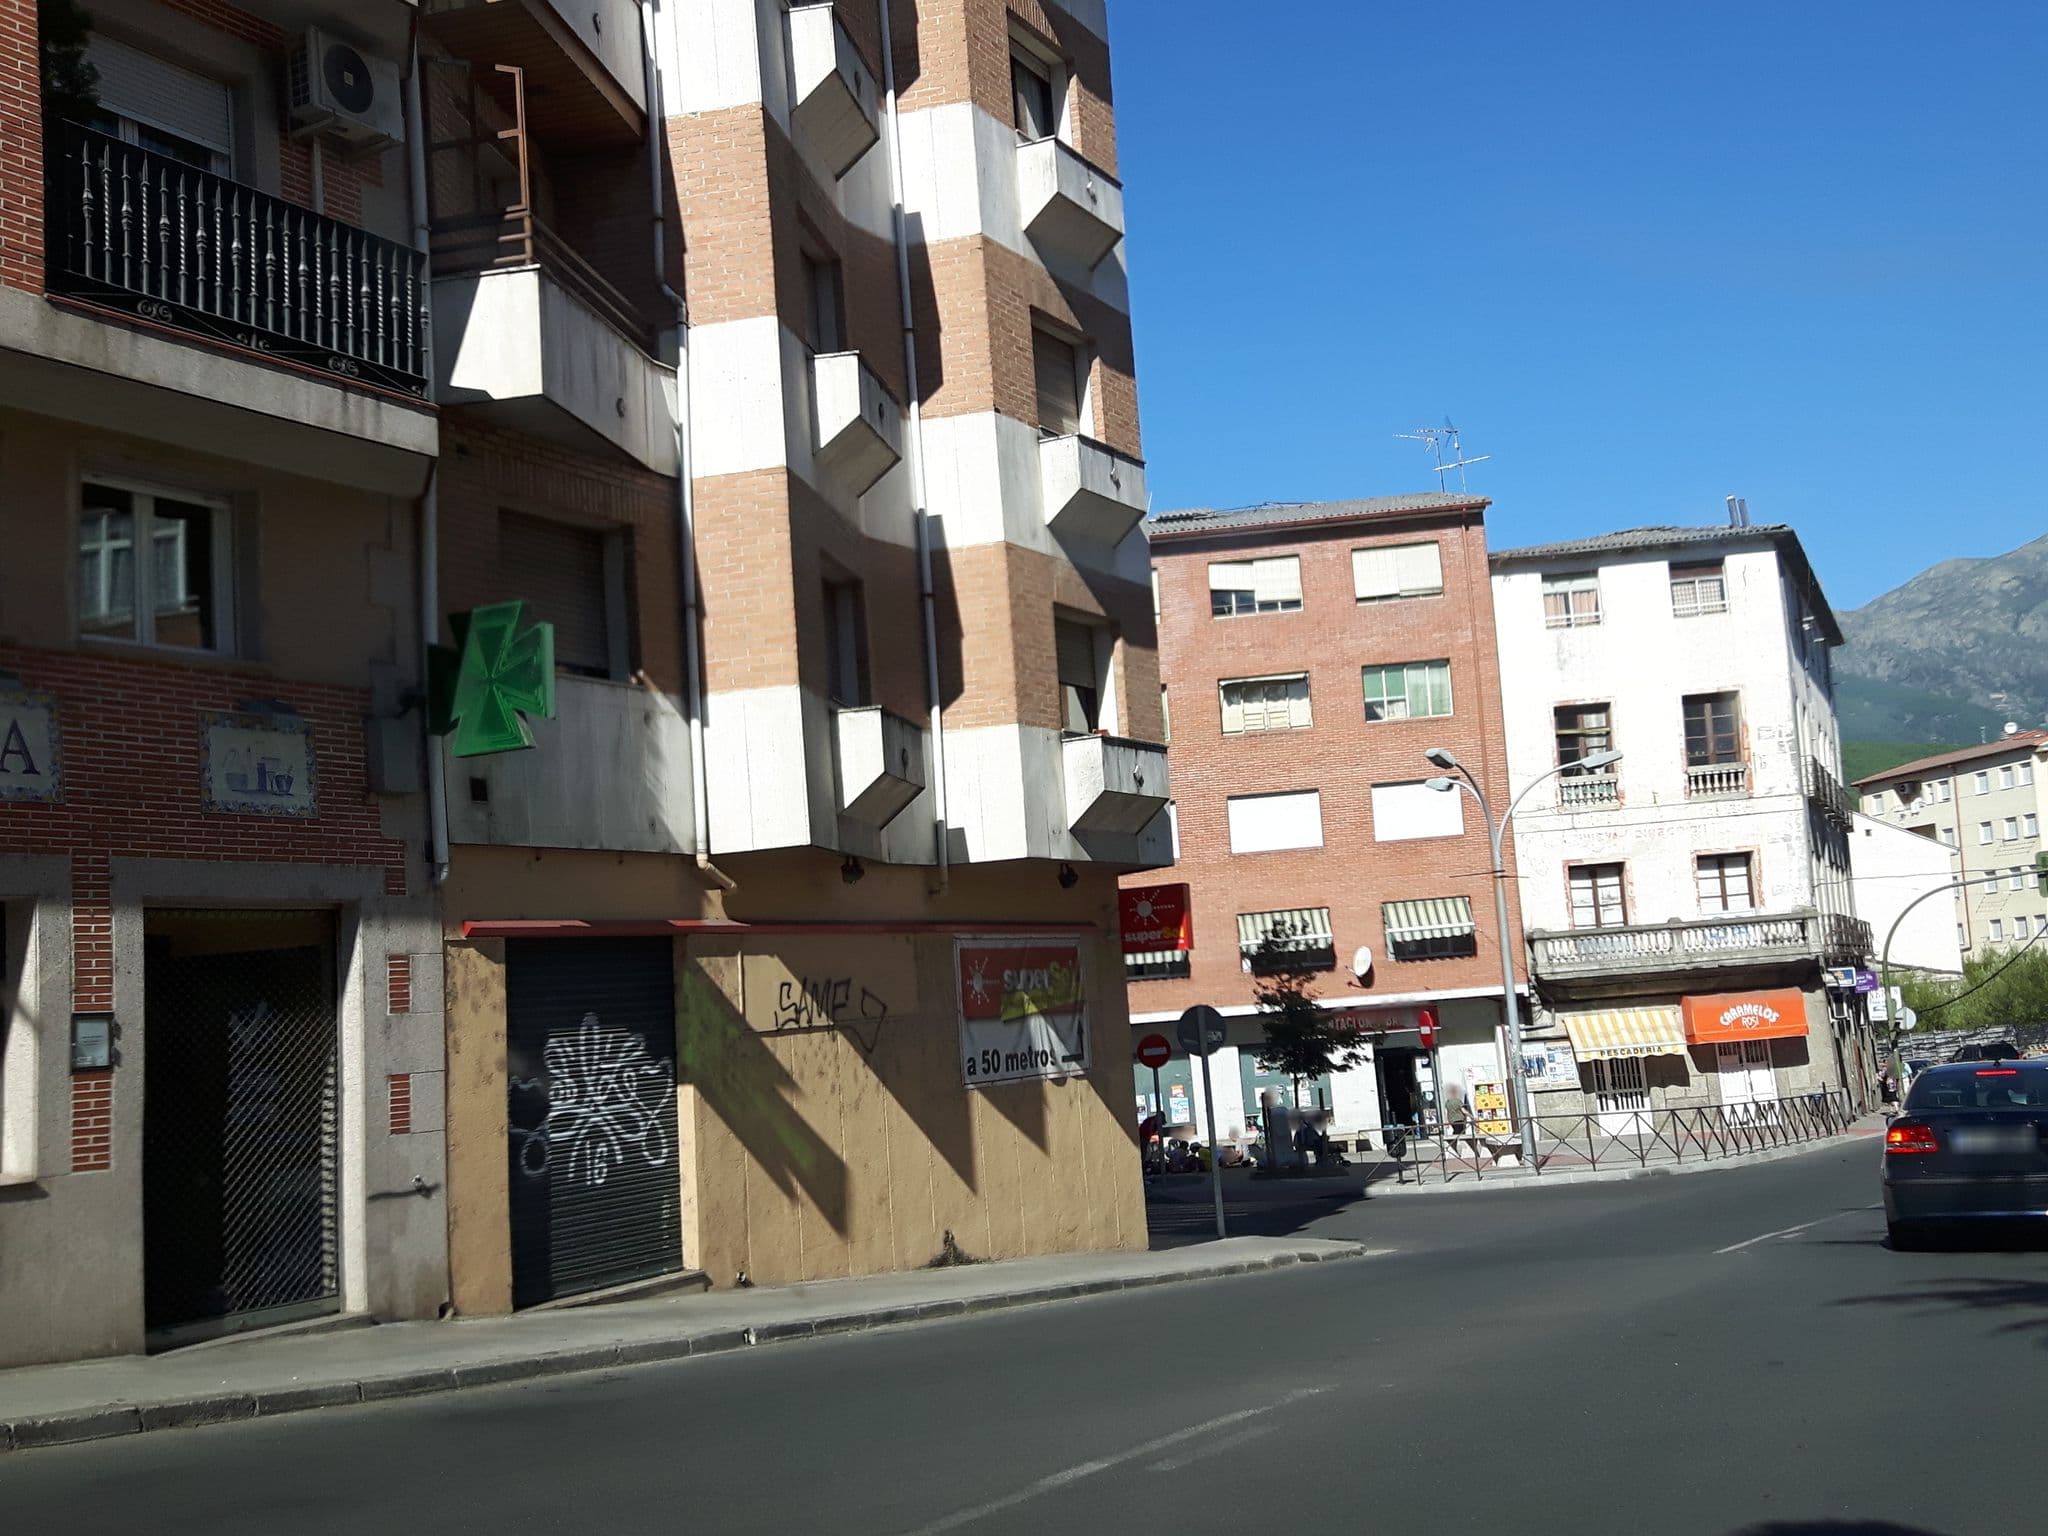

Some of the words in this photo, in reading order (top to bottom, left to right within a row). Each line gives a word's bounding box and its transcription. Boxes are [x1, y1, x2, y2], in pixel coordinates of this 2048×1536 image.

[0, 718, 41, 775] A
[1720, 1003, 1780, 1026] CARAMELOS
[967, 1056, 977, 1076] a
[982, 1049, 1001, 1075] 50
[1005, 1044, 1057, 1073] metros
[1600, 1046, 1663, 1057] PESCADERIA
